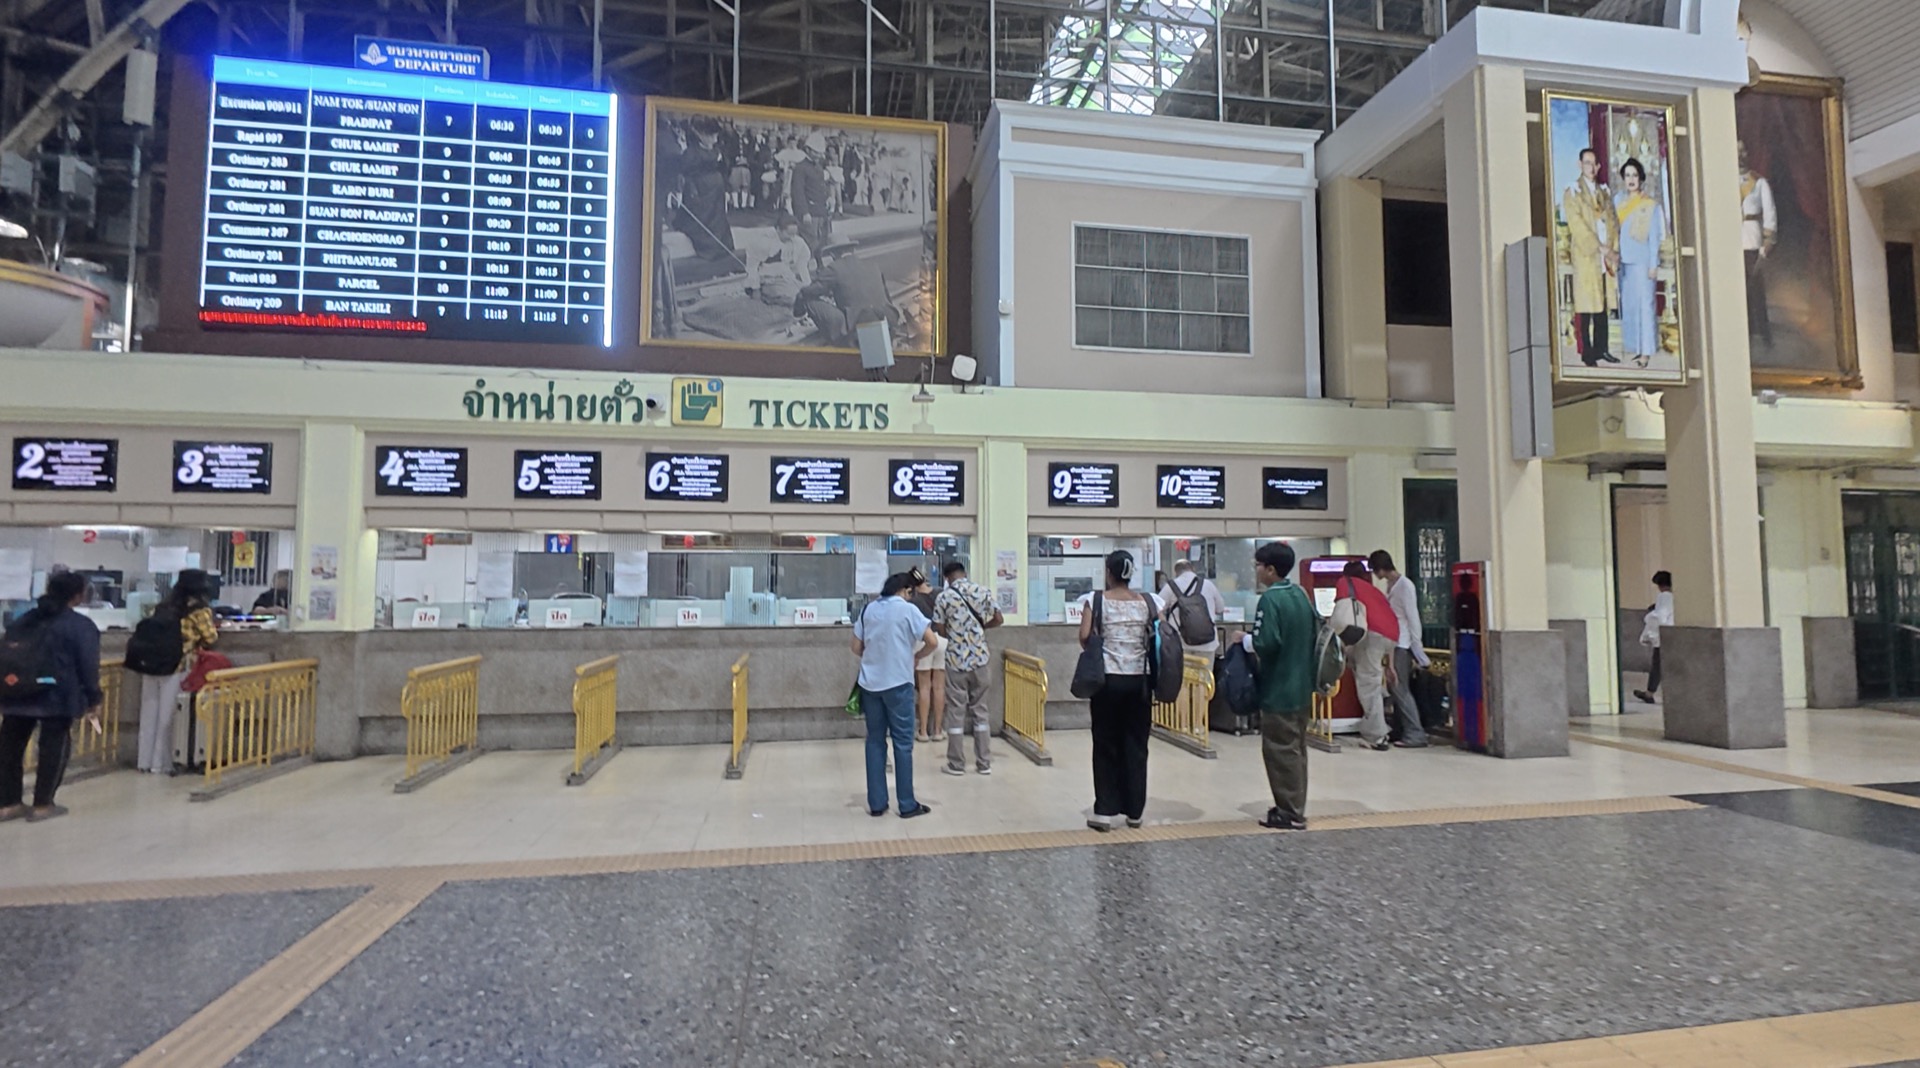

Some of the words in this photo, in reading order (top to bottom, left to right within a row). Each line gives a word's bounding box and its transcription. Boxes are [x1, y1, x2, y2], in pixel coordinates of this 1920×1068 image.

[394, 58, 476, 76] DEPARTURE
[220, 96, 265, 110] Excursion
[314, 95, 340, 108] NAM
[341, 98, 363, 109] TOK
[398, 103, 419, 114] SON
[341, 115, 392, 130] PRADIPAT
[489, 119, 515, 132] 06:30
[237, 130, 264, 144] Rapid
[538, 124, 563, 136] 06:30
[331, 138, 362, 150] CHUK
[363, 141, 399, 153] SAMET
[229, 153, 269, 168] Ordinary
[330, 161, 361, 173] CHUK
[362, 164, 398, 176] SAMET
[228, 177, 268, 191] Ordinary
[332, 184, 366, 196] KABIN
[368, 187, 394, 198] BURI
[226, 200, 267, 214] Ordinary
[309, 206, 339, 217] SUAN
[340, 208, 362, 219] SON
[364, 209, 414, 223] PRADIPAT
[221, 224, 270, 237] Commuter
[317, 230, 405, 245] CHACHOENGSAO
[486, 240, 511, 252] 10:10
[535, 243, 560, 255] 10:10
[224, 248, 265, 262] Ordinary
[323, 253, 397, 268] PHITSANULOK
[229, 271, 257, 283] Parcel
[338, 278, 380, 290] PARCEL
[437, 282, 450, 294] 10
[485, 285, 510, 297] 11:00
[534, 288, 559, 300] 11:00
[221, 295, 263, 310] Ordinary
[326, 300, 349, 311] BAN
[351, 302, 391, 314] TAKHLI
[484, 308, 509, 320] 11:15
[533, 310, 557, 323] 11:15
[462, 377, 644, 424] จำหน่ายตั๋ว
[748, 398, 890, 431] TICKETS
[17, 443, 45, 478] 2
[177, 450, 204, 484] 3
[380, 450, 405, 485] 4
[517, 459, 541, 491] 5
[648, 460, 671, 492] 6
[774, 464, 795, 495] 7
[893, 466, 914, 497] 8
[1053, 470, 1072, 499] 9
[1160, 474, 1182, 496] 10
[84, 529, 97, 543] 2
[1072, 537, 1081, 550] 9
